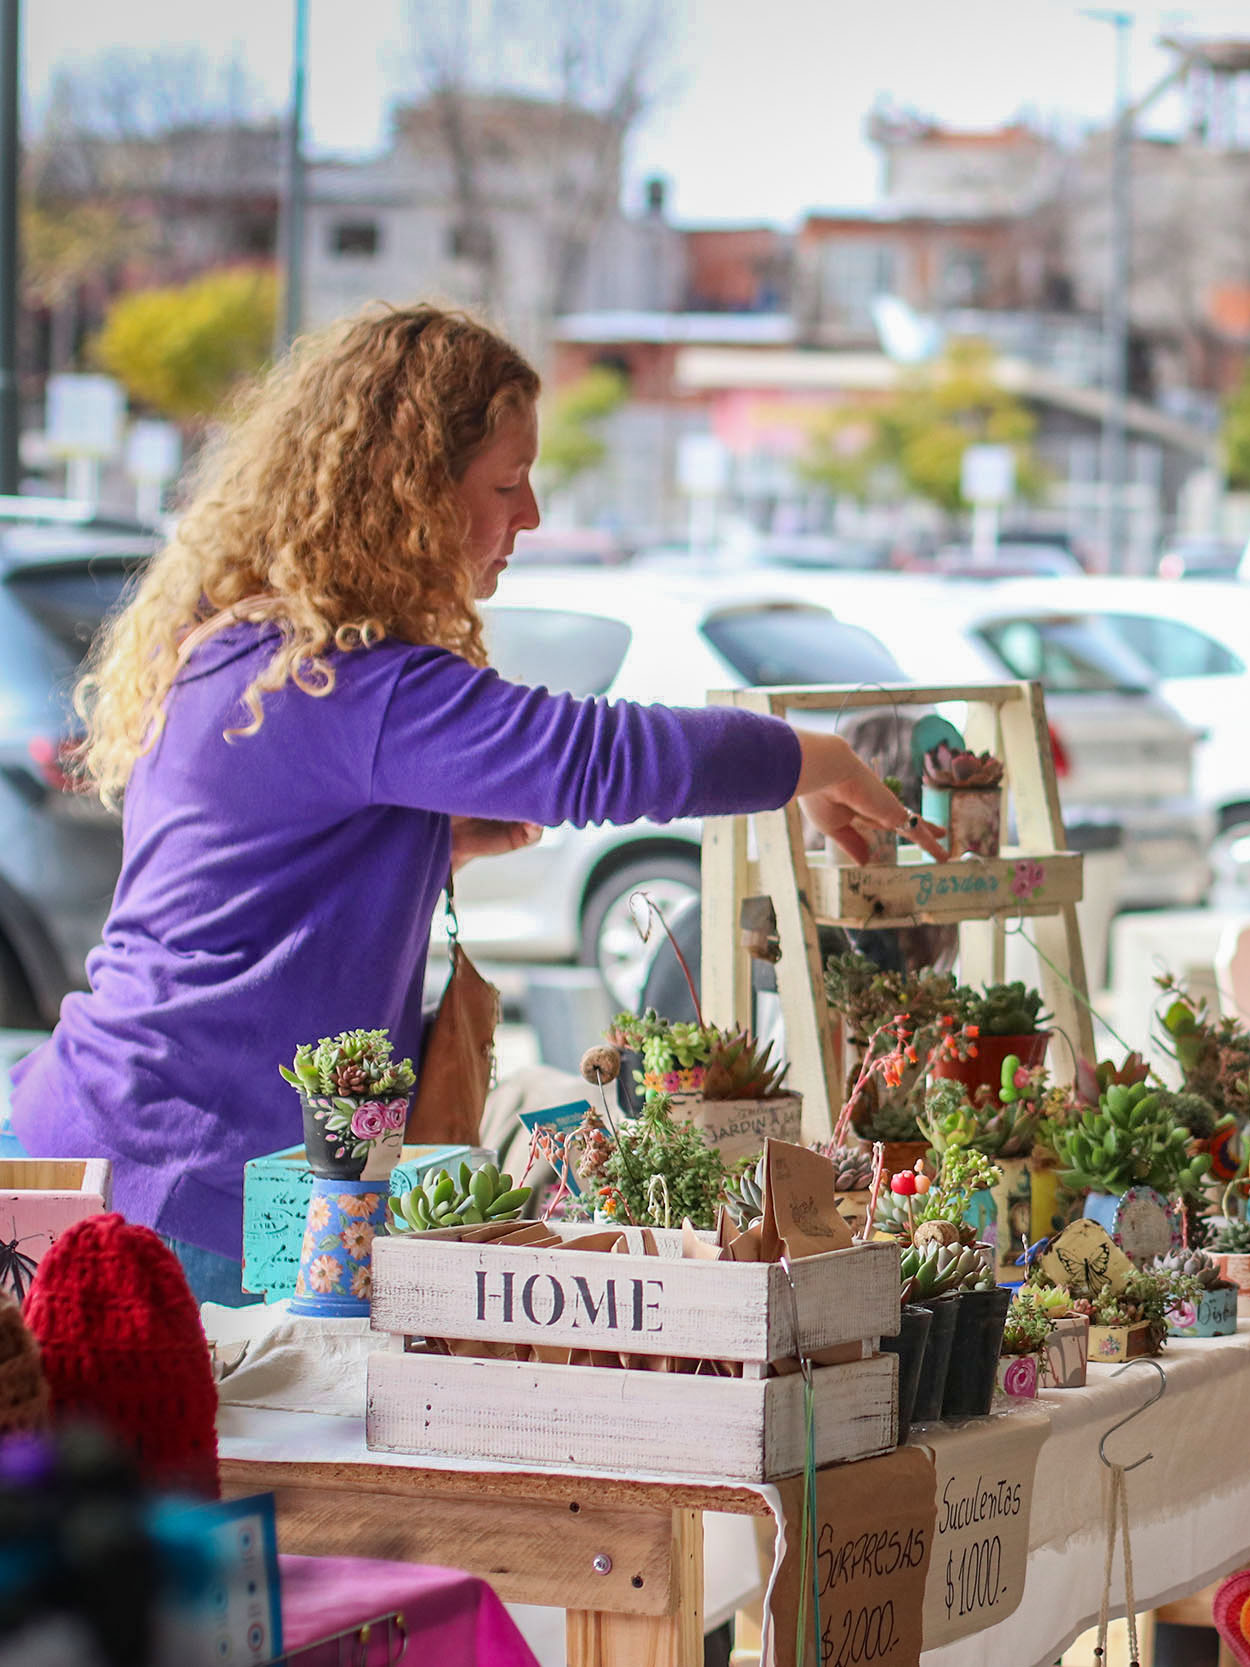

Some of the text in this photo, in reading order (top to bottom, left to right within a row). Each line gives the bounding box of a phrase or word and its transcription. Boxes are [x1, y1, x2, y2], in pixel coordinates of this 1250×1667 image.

[704, 1115, 766, 1143] JARDIN
[475, 1271, 664, 1332] HOME
[938, 1474, 1021, 1534] Suculentas
